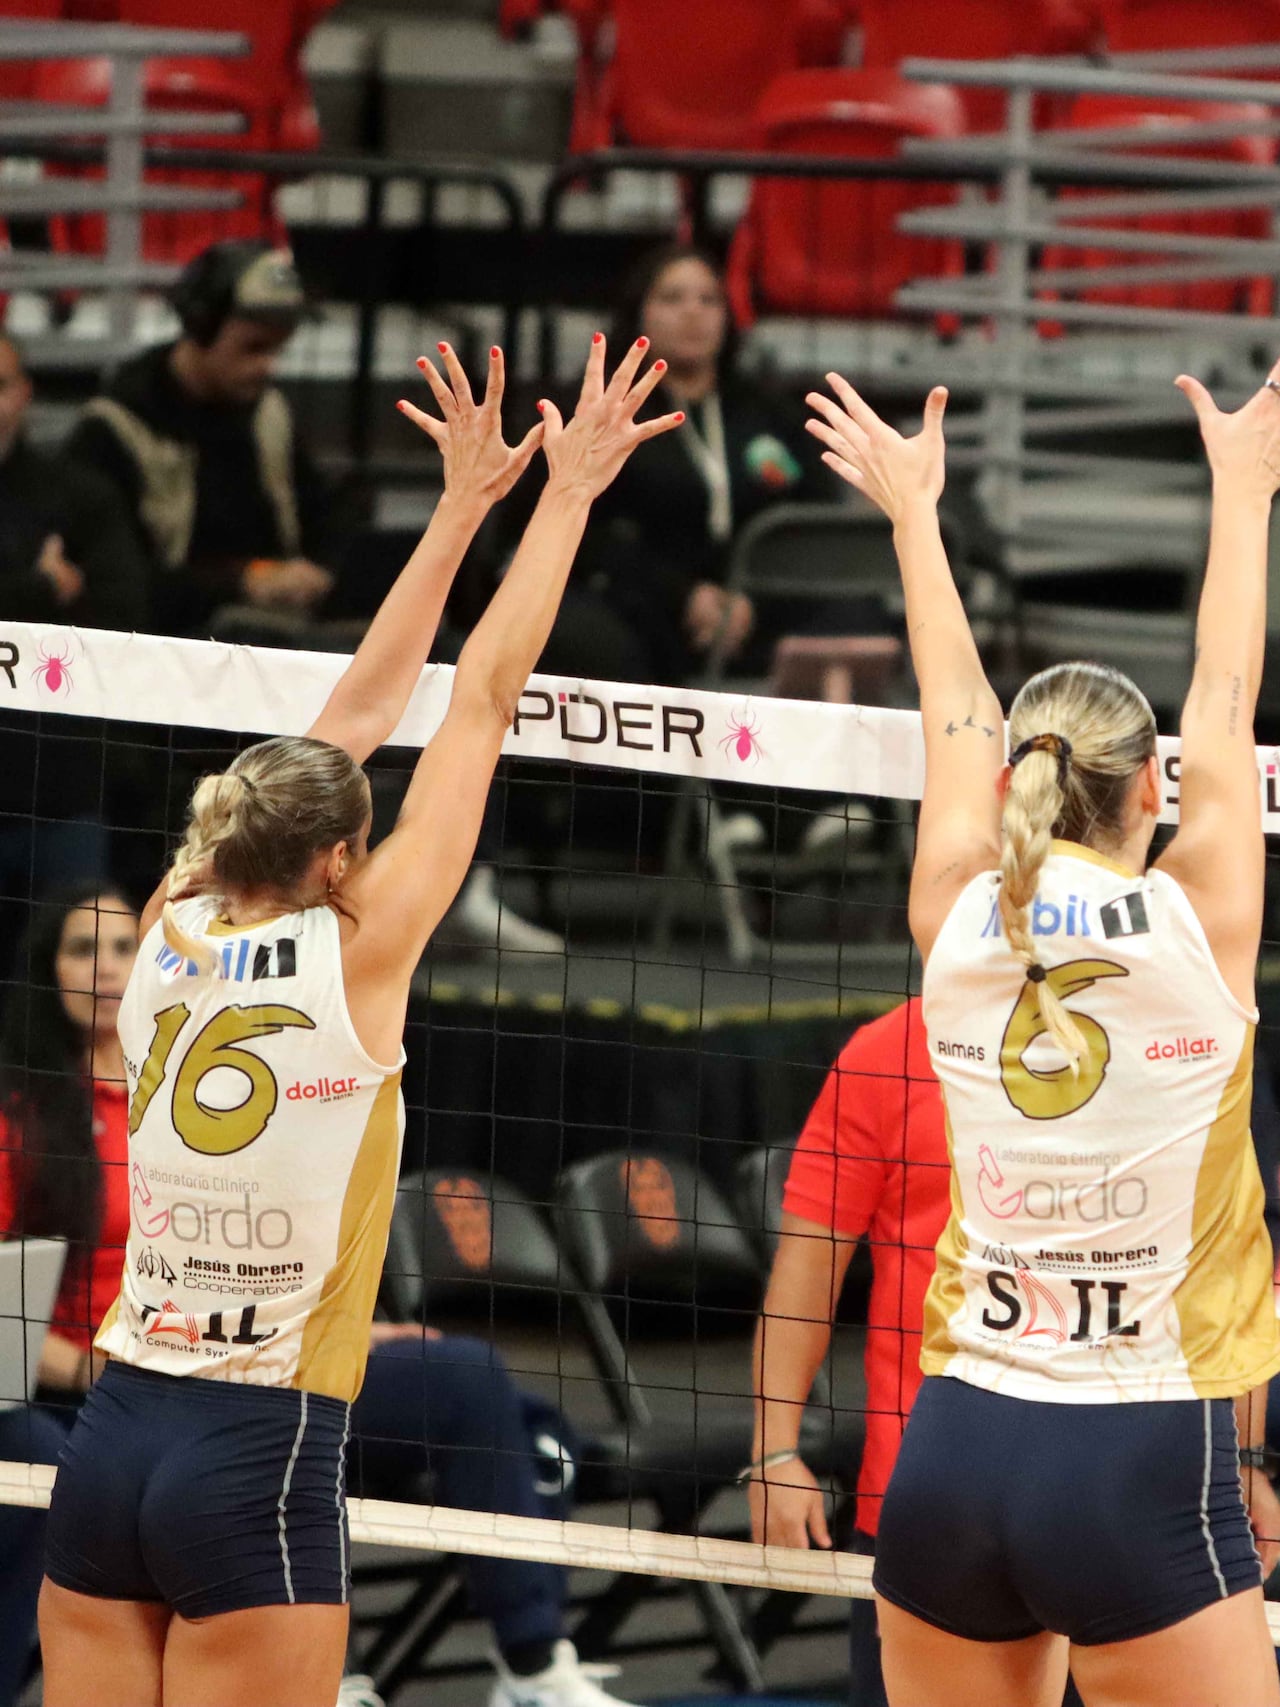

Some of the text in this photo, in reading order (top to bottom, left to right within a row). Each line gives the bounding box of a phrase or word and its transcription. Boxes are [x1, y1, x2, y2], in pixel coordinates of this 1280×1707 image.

[513, 690, 704, 758] PIDER
[1000, 957, 1130, 1121] 6
[128, 1001, 316, 1157] 16
[143, 1165, 210, 1191] Laboratorio
[1091, 1245, 1158, 1264] Obrero
[184, 1256, 303, 1277] Jesús Obrero
[184, 1276, 303, 1296] Cooperativa
[146, 1338, 201, 1355] Computer
